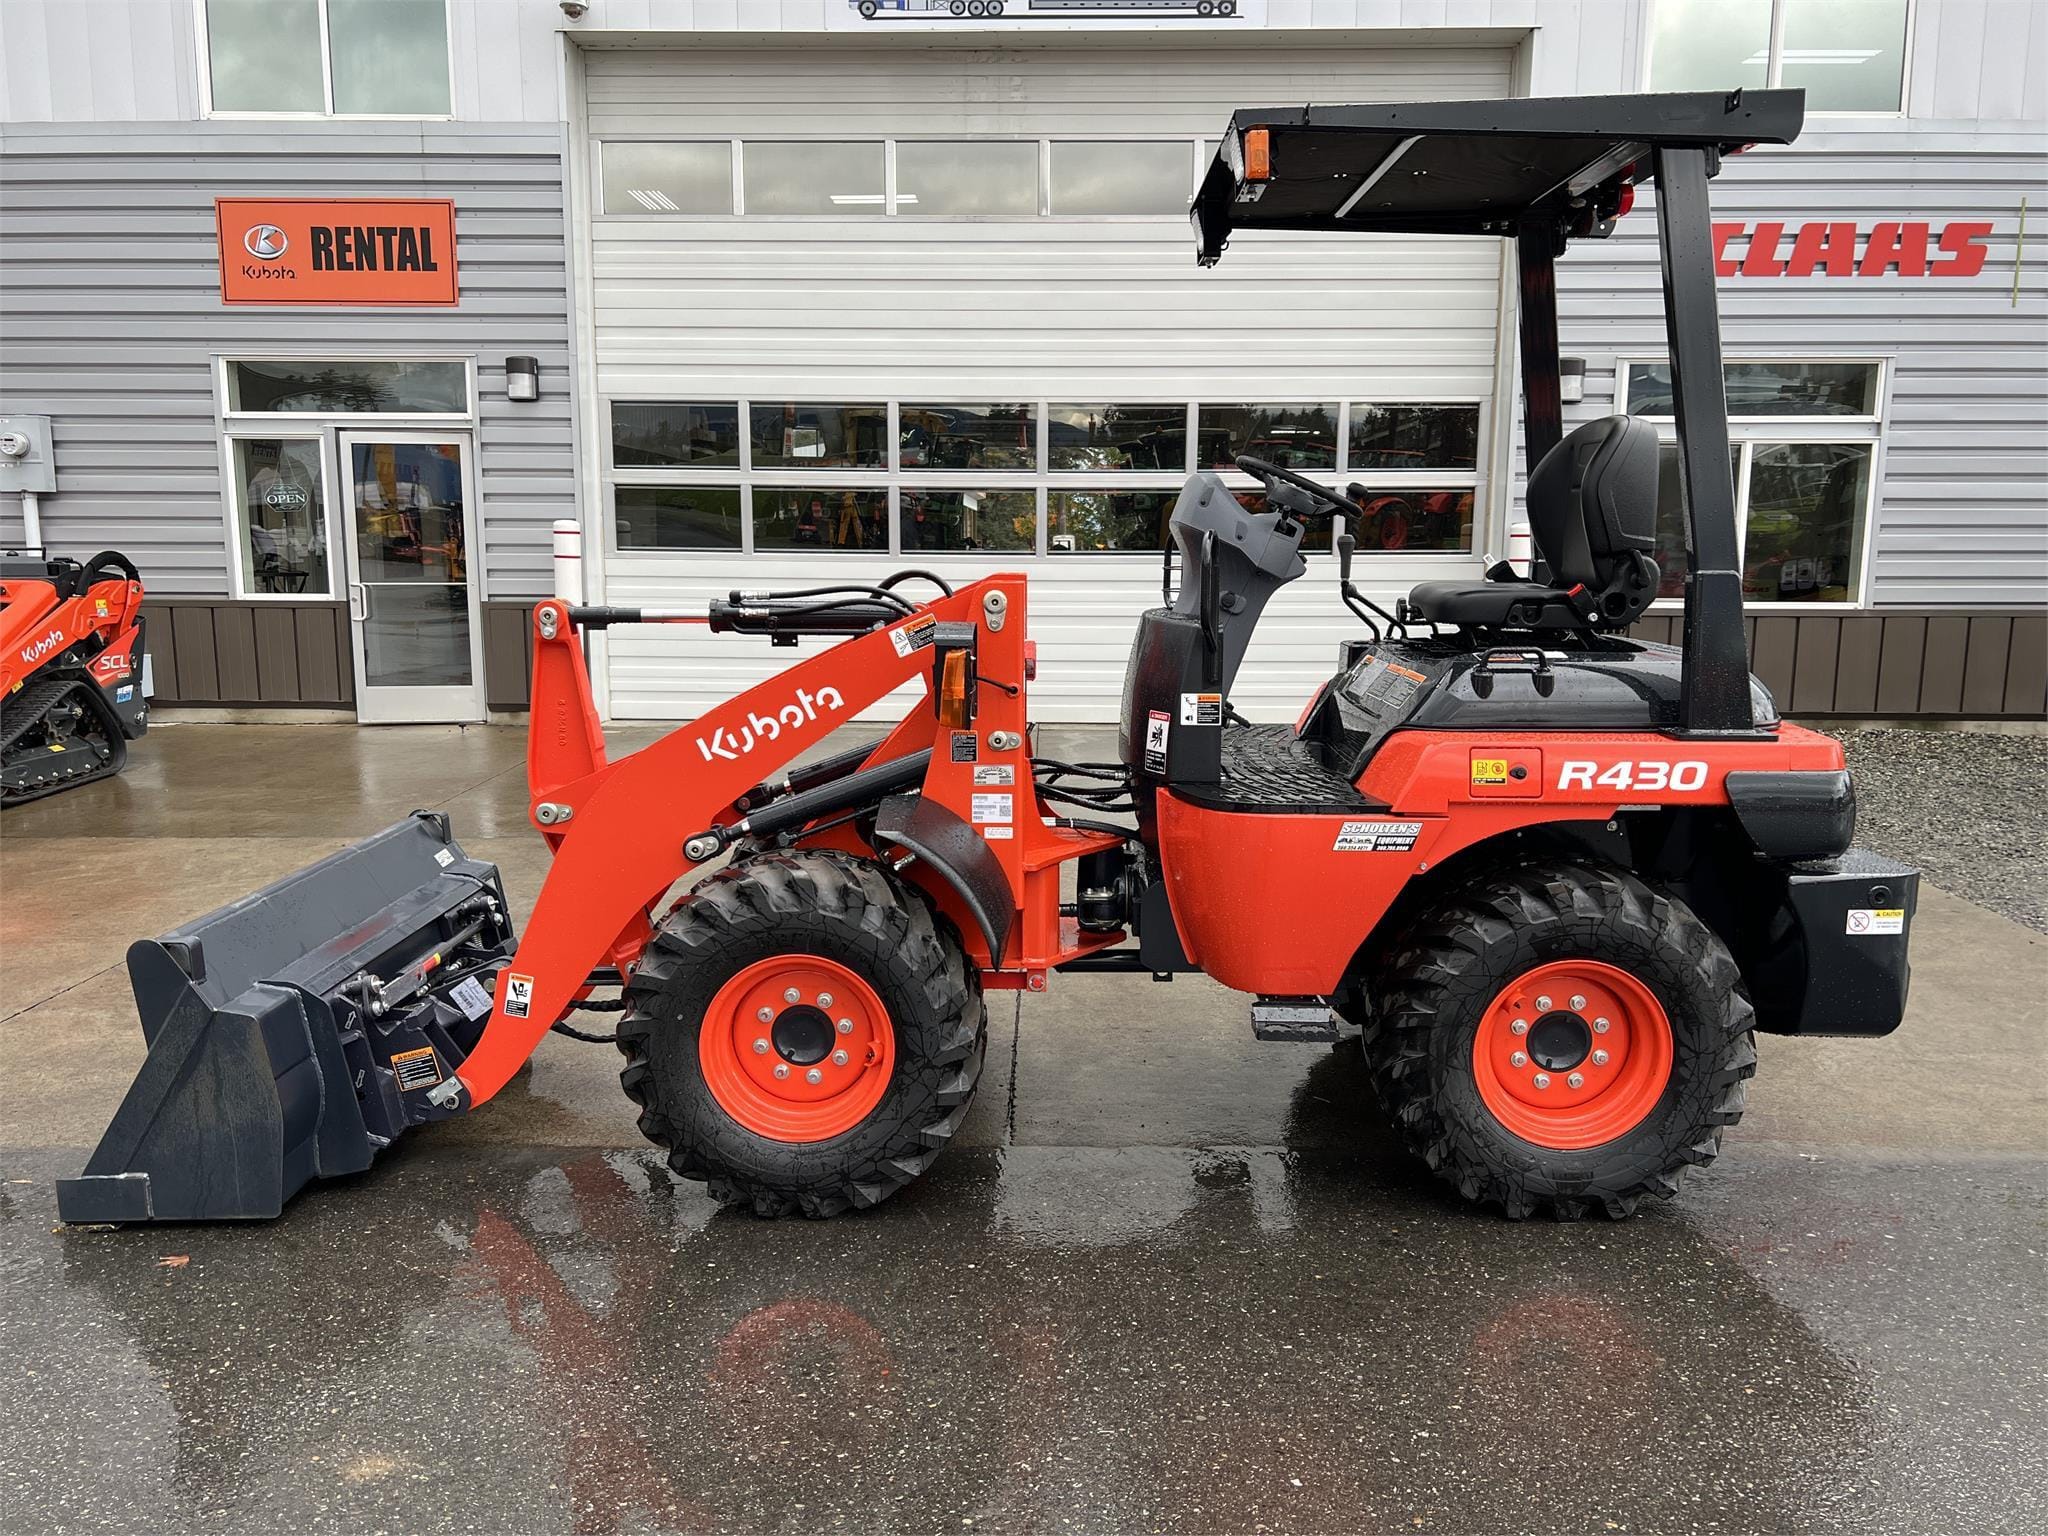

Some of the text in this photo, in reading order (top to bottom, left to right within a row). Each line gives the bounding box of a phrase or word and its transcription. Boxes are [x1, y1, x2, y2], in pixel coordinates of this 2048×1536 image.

[310, 226, 438, 272] RENTAL
[1711, 222, 1994, 277] CLAAS
[241, 264, 296, 280] Kubota
[266, 494, 306, 504] OPEN
[21, 629, 64, 663] Kubota
[100, 655, 129, 670] SCL
[695, 686, 846, 762] Kubota
[1557, 760, 1709, 791] R430
[1342, 823, 1420, 834] SCHOLTEN'S
[1376, 836, 1416, 845] EQUIPMENT
